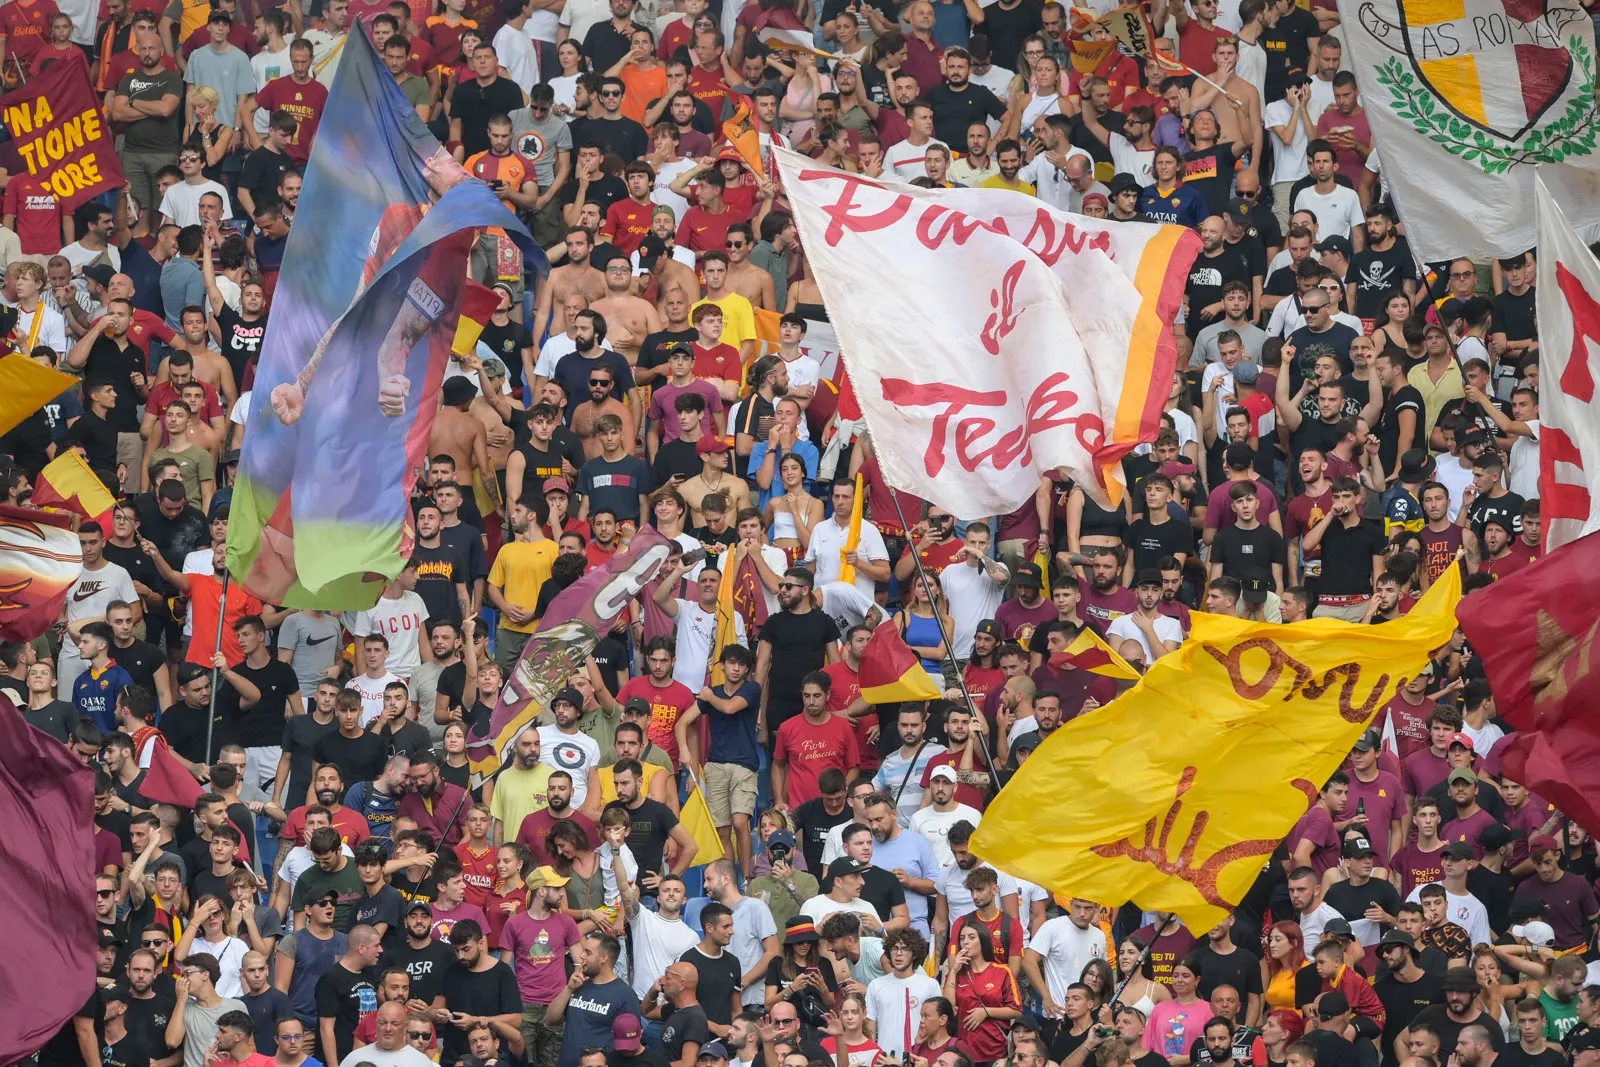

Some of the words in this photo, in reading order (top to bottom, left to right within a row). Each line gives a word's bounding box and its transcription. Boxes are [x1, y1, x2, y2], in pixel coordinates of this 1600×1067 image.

[1369, 20, 1389, 38] 19
[1422, 23, 1460, 59] AS
[1472, 13, 1559, 50] ROMA
[4, 96, 54, 137] 'NA
[18, 108, 102, 175] TIONE
[980, 259, 1027, 356] il
[78, 580, 102, 593] NIKE
[463, 873, 491, 885] QATAR
[1411, 868, 1439, 878] Voglio
[1151, 953, 1162, 961] SEI
[1163, 952, 1174, 961] TU
[406, 960, 433, 976] ASR
